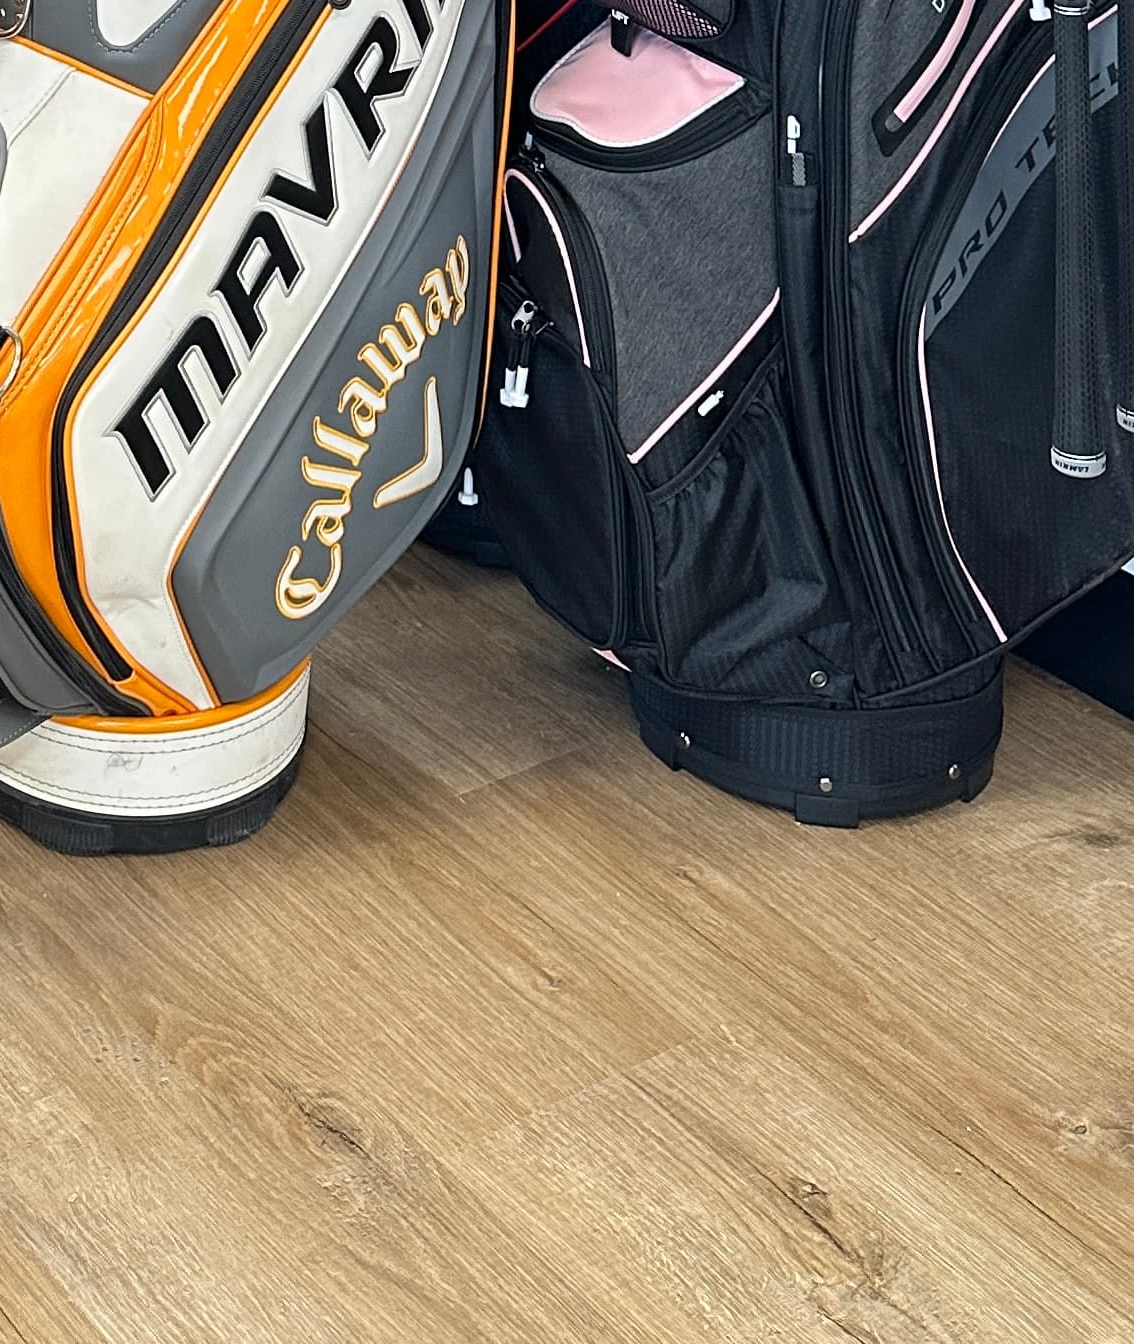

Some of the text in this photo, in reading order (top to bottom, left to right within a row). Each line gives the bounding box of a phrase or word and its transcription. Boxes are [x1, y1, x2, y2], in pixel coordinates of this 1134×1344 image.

[930, 188, 1008, 316] PRO
[274, 234, 472, 620] Callaway
[1055, 459, 1090, 473] LAMKIN
